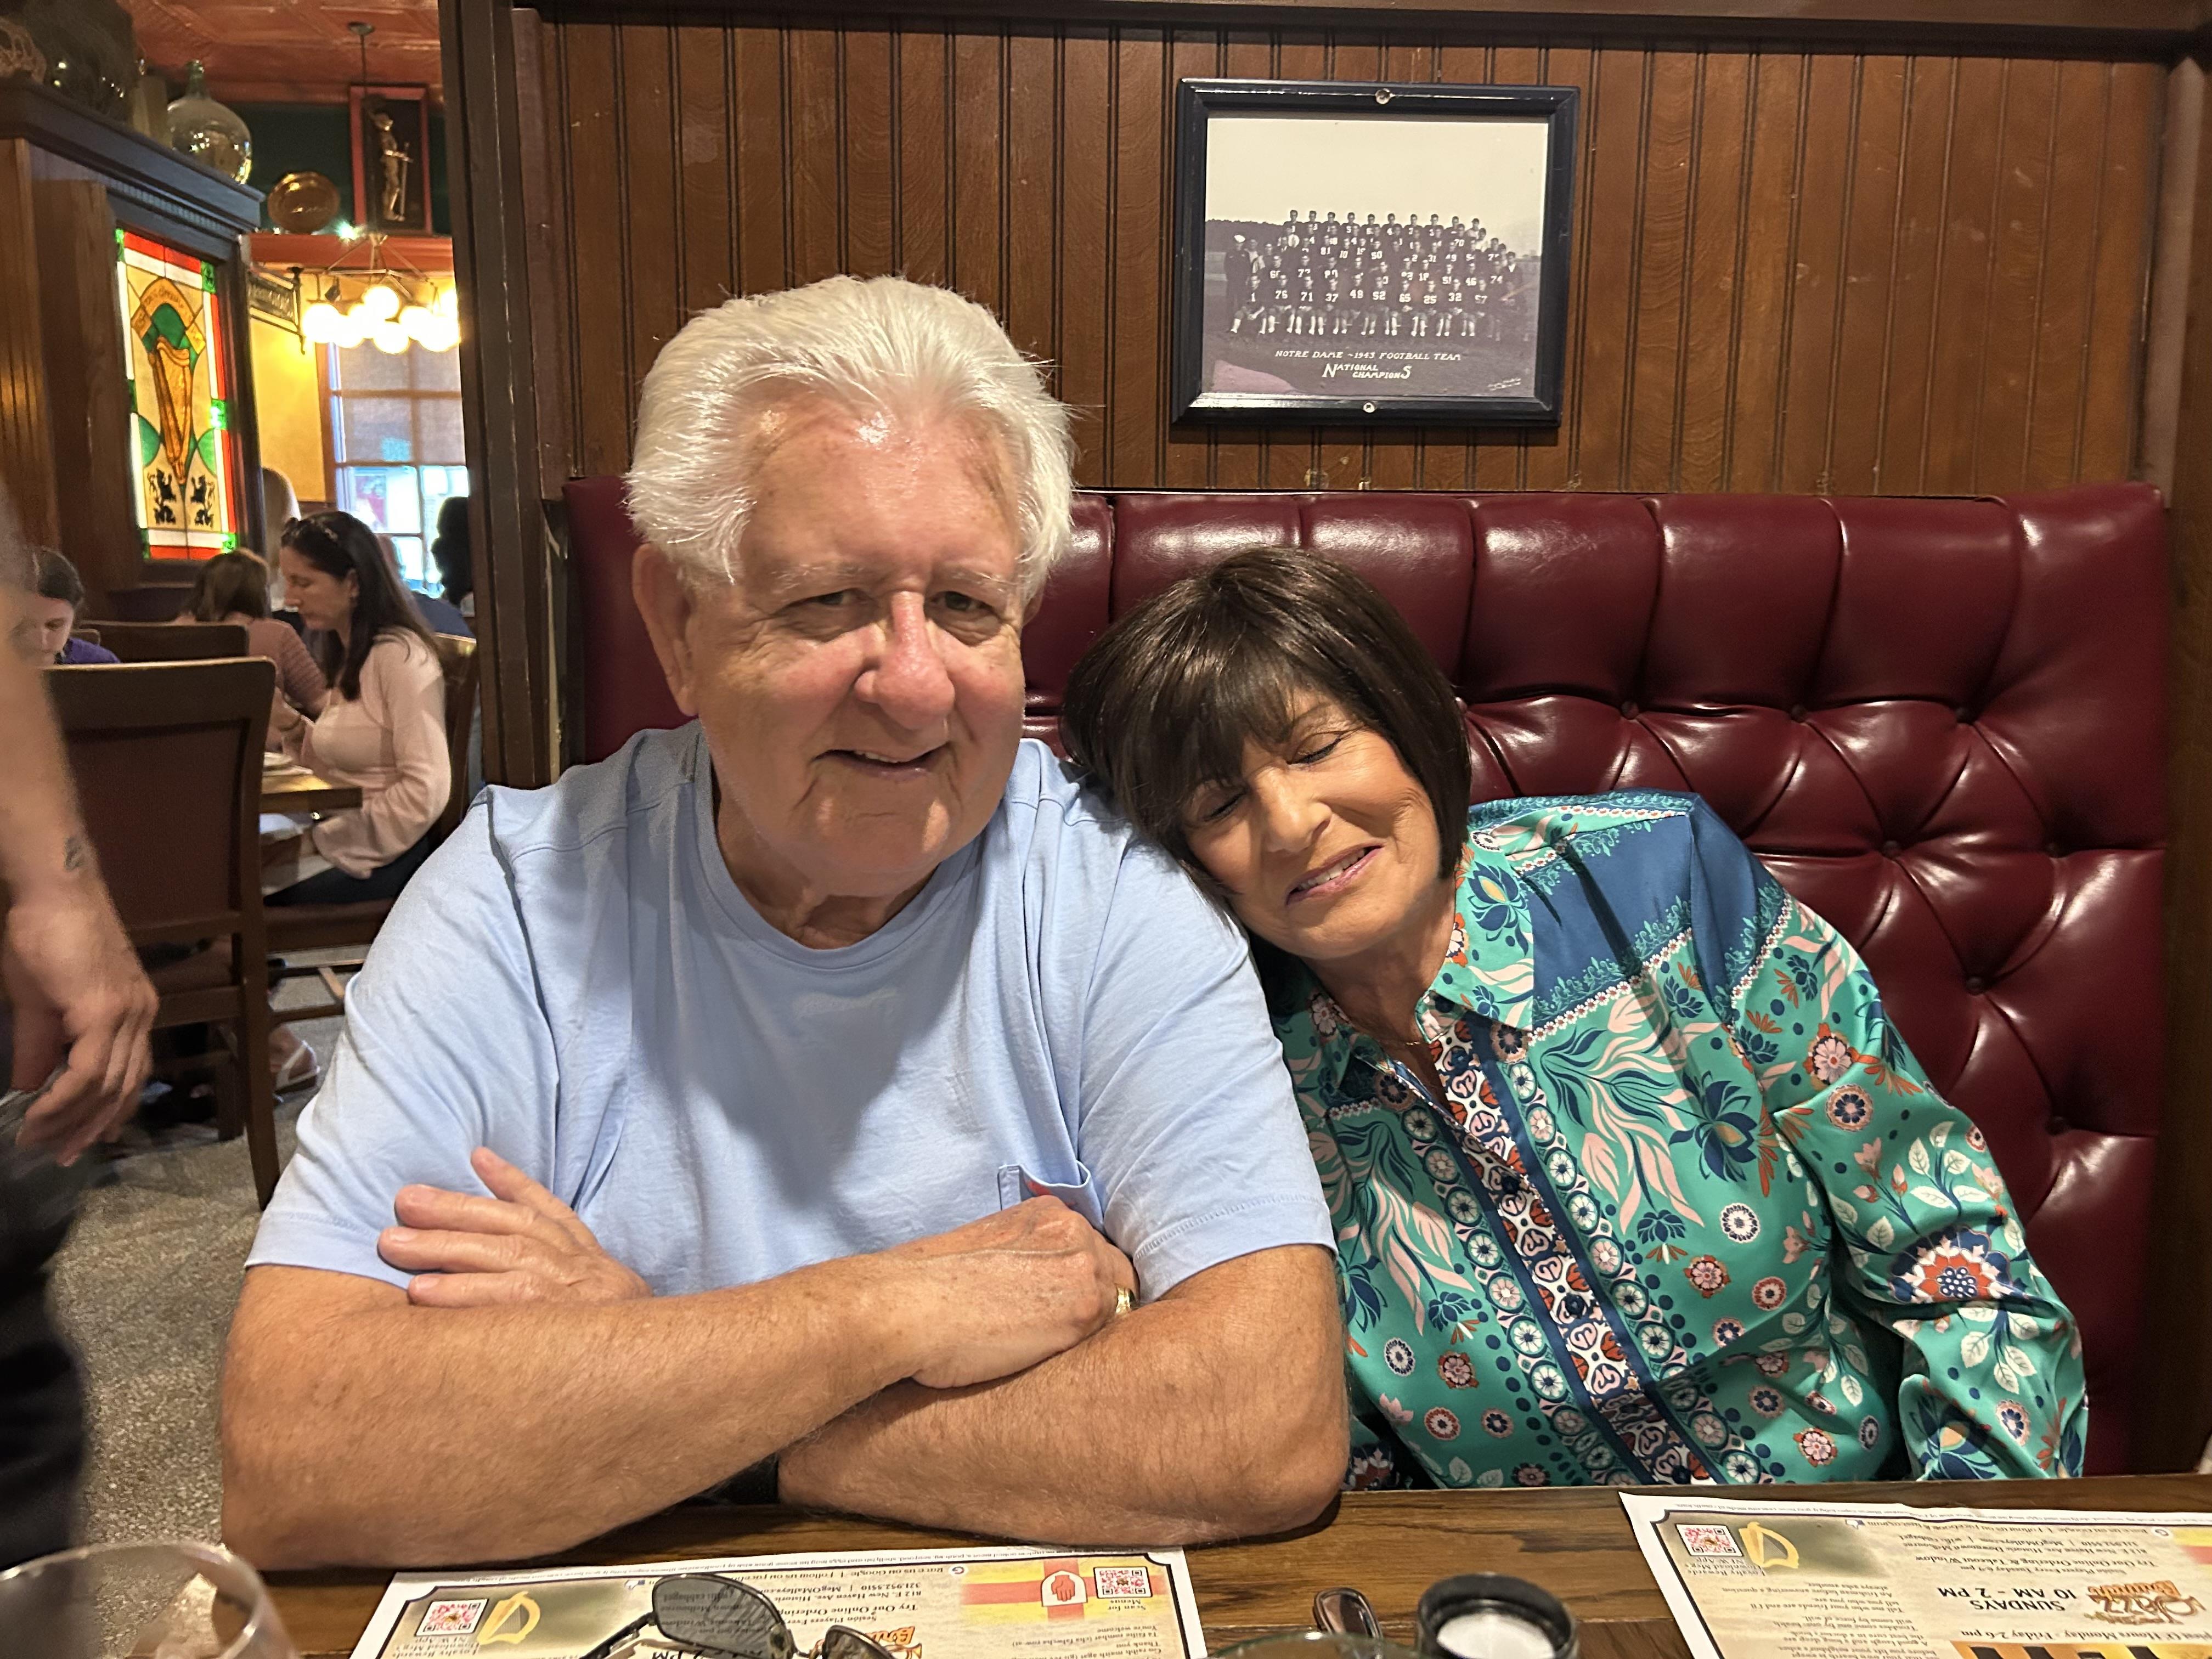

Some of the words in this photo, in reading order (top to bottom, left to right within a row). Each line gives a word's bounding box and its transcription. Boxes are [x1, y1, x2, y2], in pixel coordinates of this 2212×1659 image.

[1301, 292, 1313, 301] 71
[1325, 294, 1339, 302] 37
[1373, 291, 1386, 300] 52
[1424, 295, 1437, 304] 25
[1448, 292, 1462, 302] 32
[1322, 363, 1378, 377] NATIONAL
[1352, 365, 1412, 379] CHAMPIONS
[1937, 1588, 1971, 1598] PM
[1975, 1588, 1991, 1598] 2
[2011, 1588, 2045, 1598] AM
[2053, 1589, 2076, 1599] 10
[899, 1603, 917, 1611] Try
[1970, 1600, 2065, 1611] SUNDAYS
[2012, 1630, 2053, 1640] Friday
[2064, 1630, 2118, 1640] Monday
